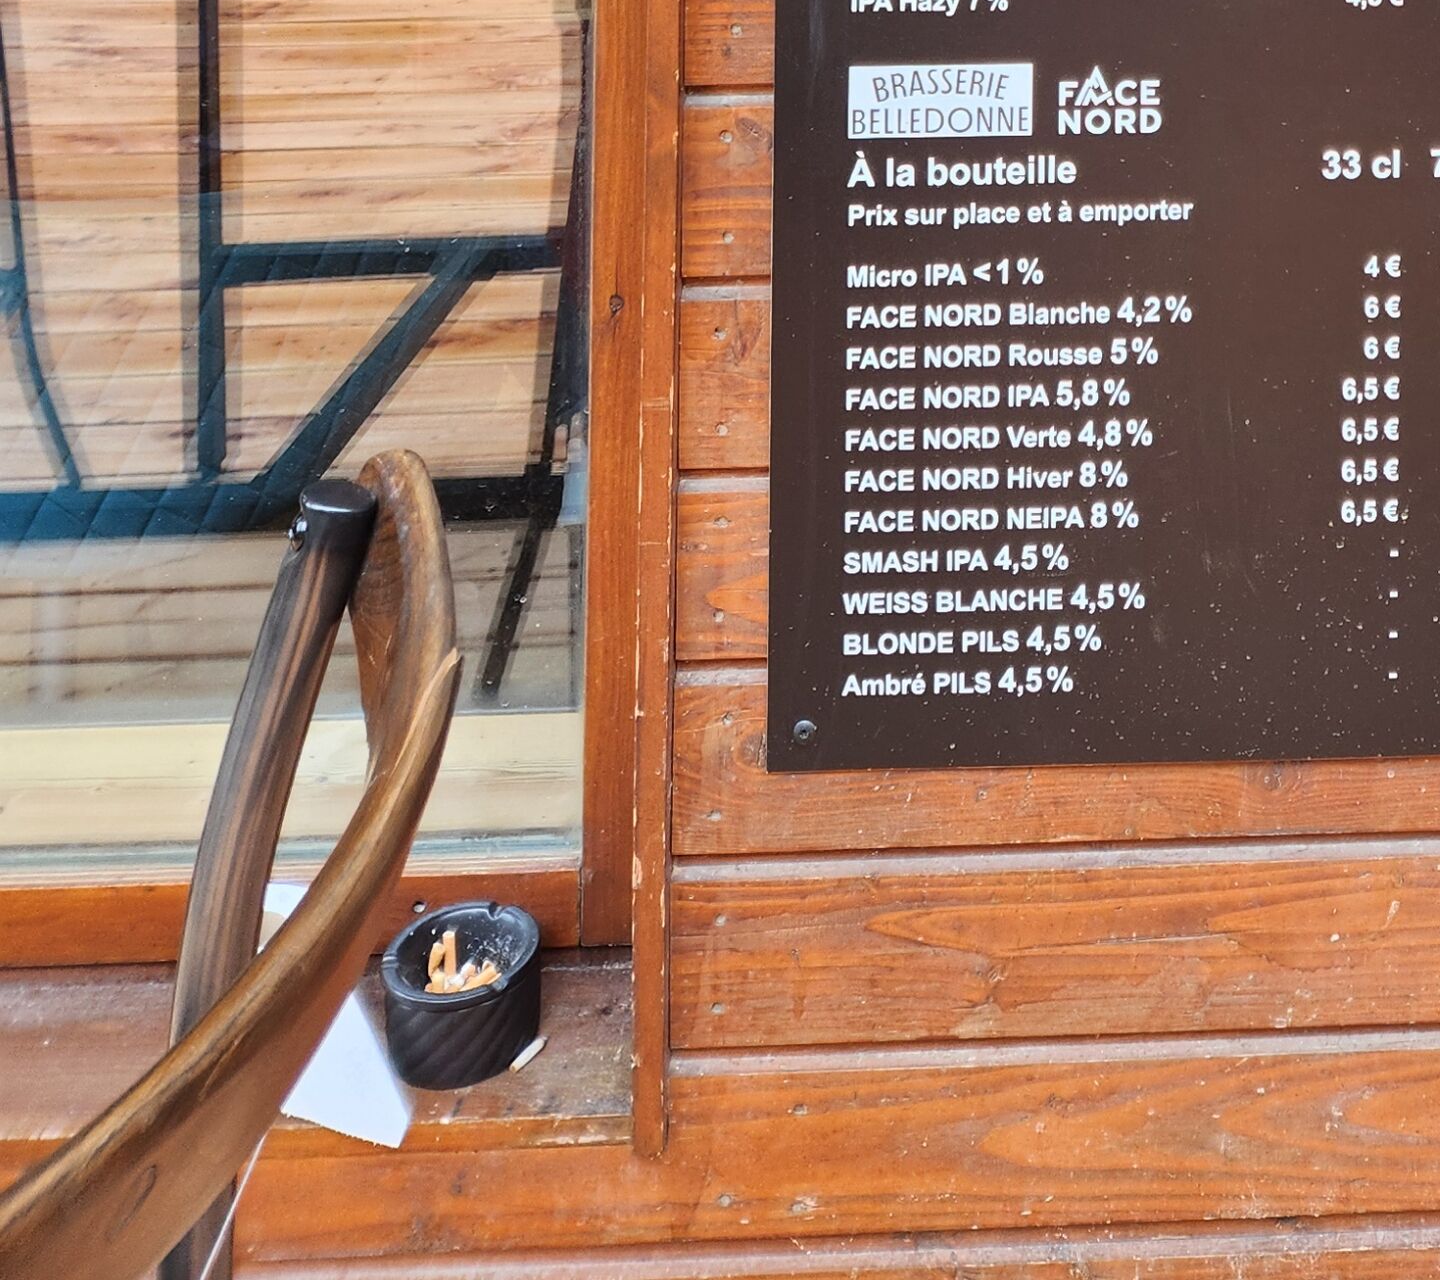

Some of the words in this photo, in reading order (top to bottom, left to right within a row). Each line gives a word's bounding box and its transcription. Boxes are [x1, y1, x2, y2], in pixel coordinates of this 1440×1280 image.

[872, 69, 1009, 102] BRASSERIE
[852, 107, 1029, 135] BELLEDONNE
[1057, 108, 1162, 135] NORD
[846, 149, 876, 189] À
[885, 157, 916, 188] la
[926, 153, 1078, 187] bouteille
[847, 203, 899, 227] Prix
[904, 207, 948, 226] sur
[952, 201, 1021, 231] place
[1026, 201, 1052, 224] et
[1057, 199, 1074, 223] à
[1078, 198, 1195, 227] emporter
[845, 304, 918, 330] FACE
[924, 302, 1002, 328] NORD
[1008, 300, 1112, 326] Blanche
[841, 590, 929, 615] WEISS
[935, 587, 1064, 614] BLANCHE
